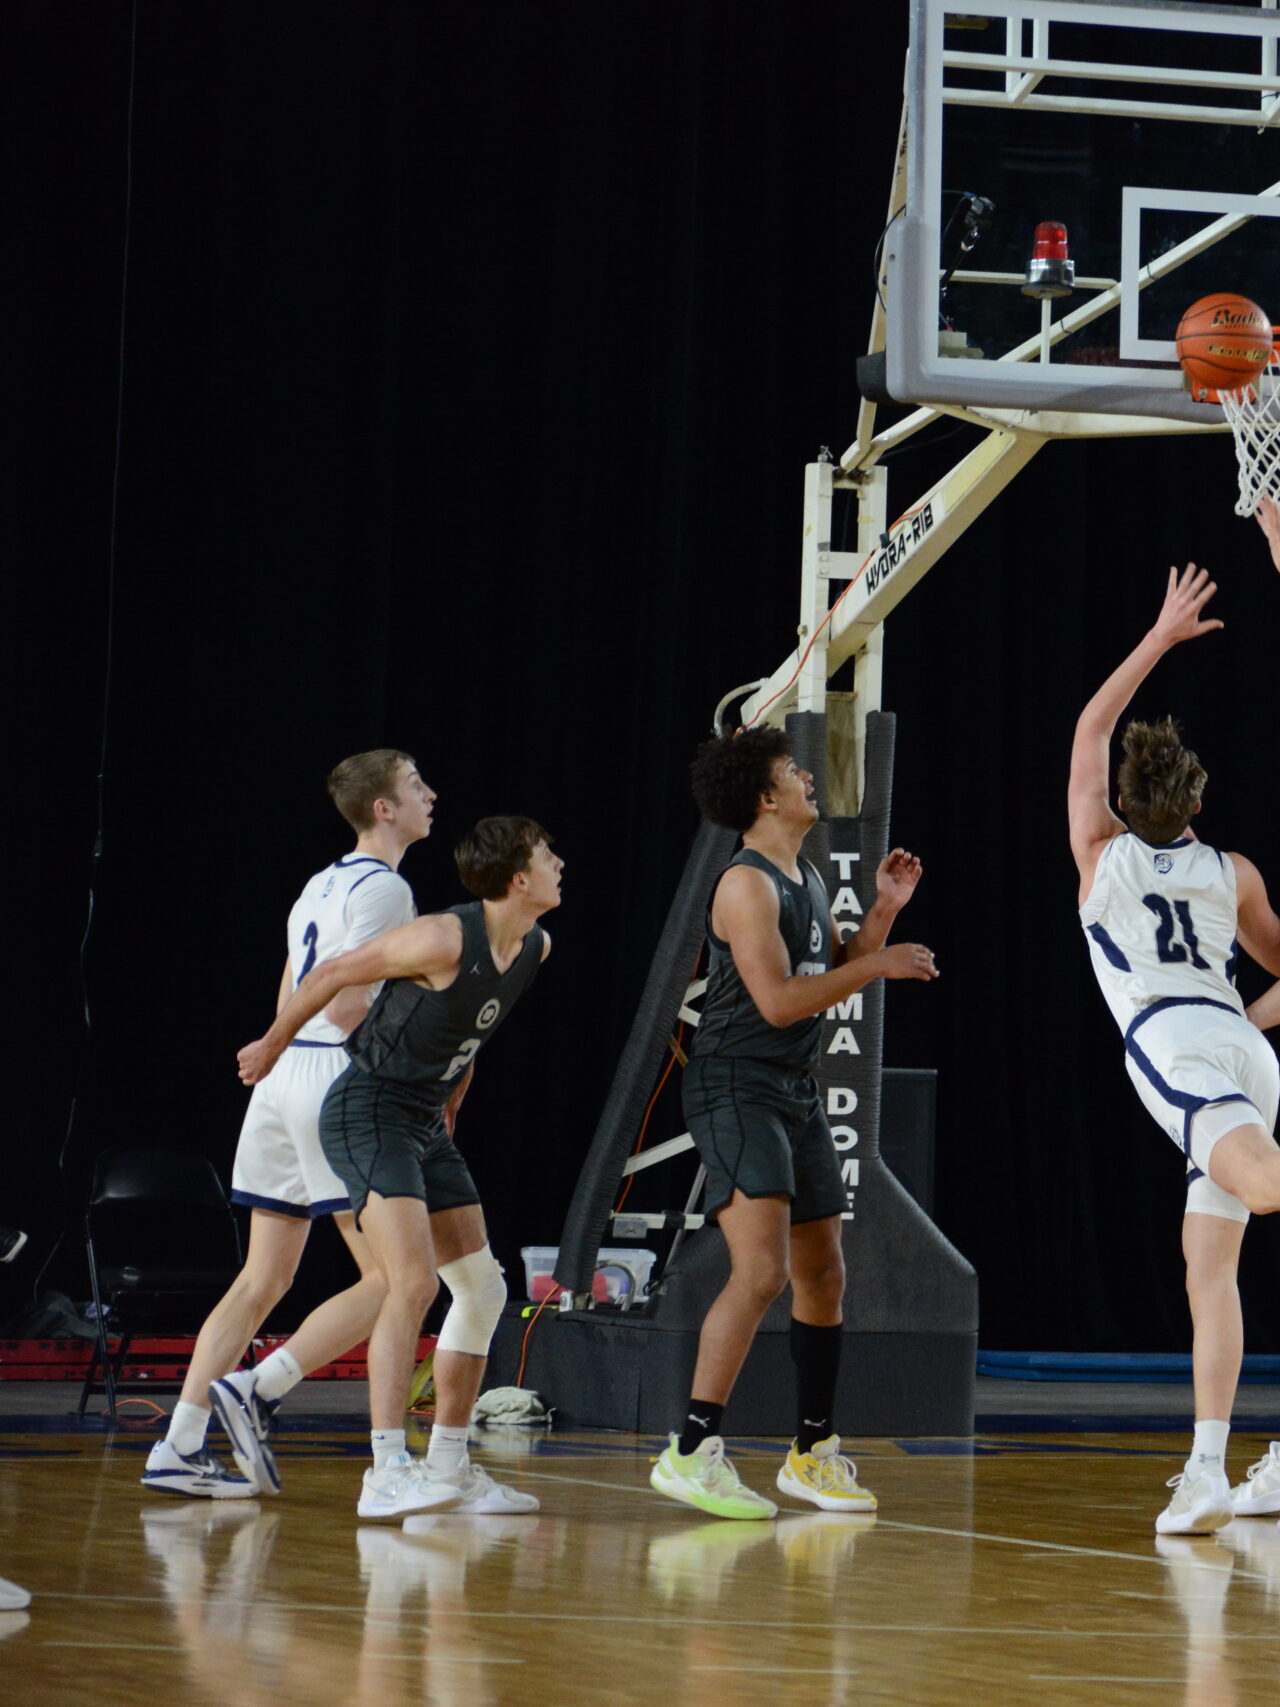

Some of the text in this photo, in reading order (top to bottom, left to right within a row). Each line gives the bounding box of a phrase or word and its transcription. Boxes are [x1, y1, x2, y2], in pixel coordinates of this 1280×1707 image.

[865, 502, 934, 596] HYDRA-RIB
[825, 853, 864, 1055] TACMA
[1142, 893, 1212, 970] 21
